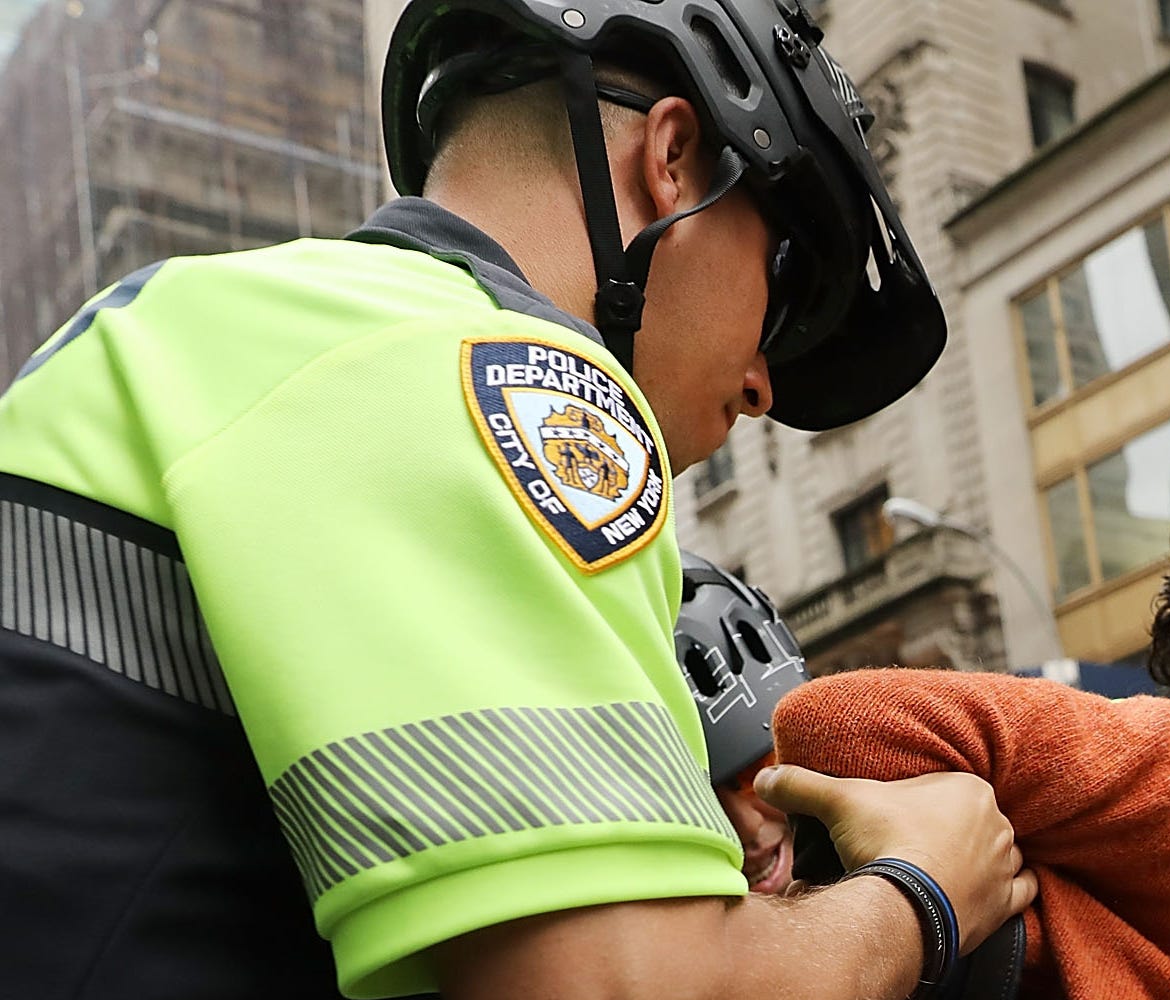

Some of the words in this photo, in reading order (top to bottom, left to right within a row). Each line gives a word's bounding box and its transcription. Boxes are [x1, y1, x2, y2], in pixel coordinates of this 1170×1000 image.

[486, 364, 655, 455] DEPARTMENT
[527, 346, 626, 407] POLICE
[488, 413, 535, 470] CITY
[528, 479, 567, 515] OF
[600, 507, 646, 545] NEW
[636, 468, 664, 516] YORK
